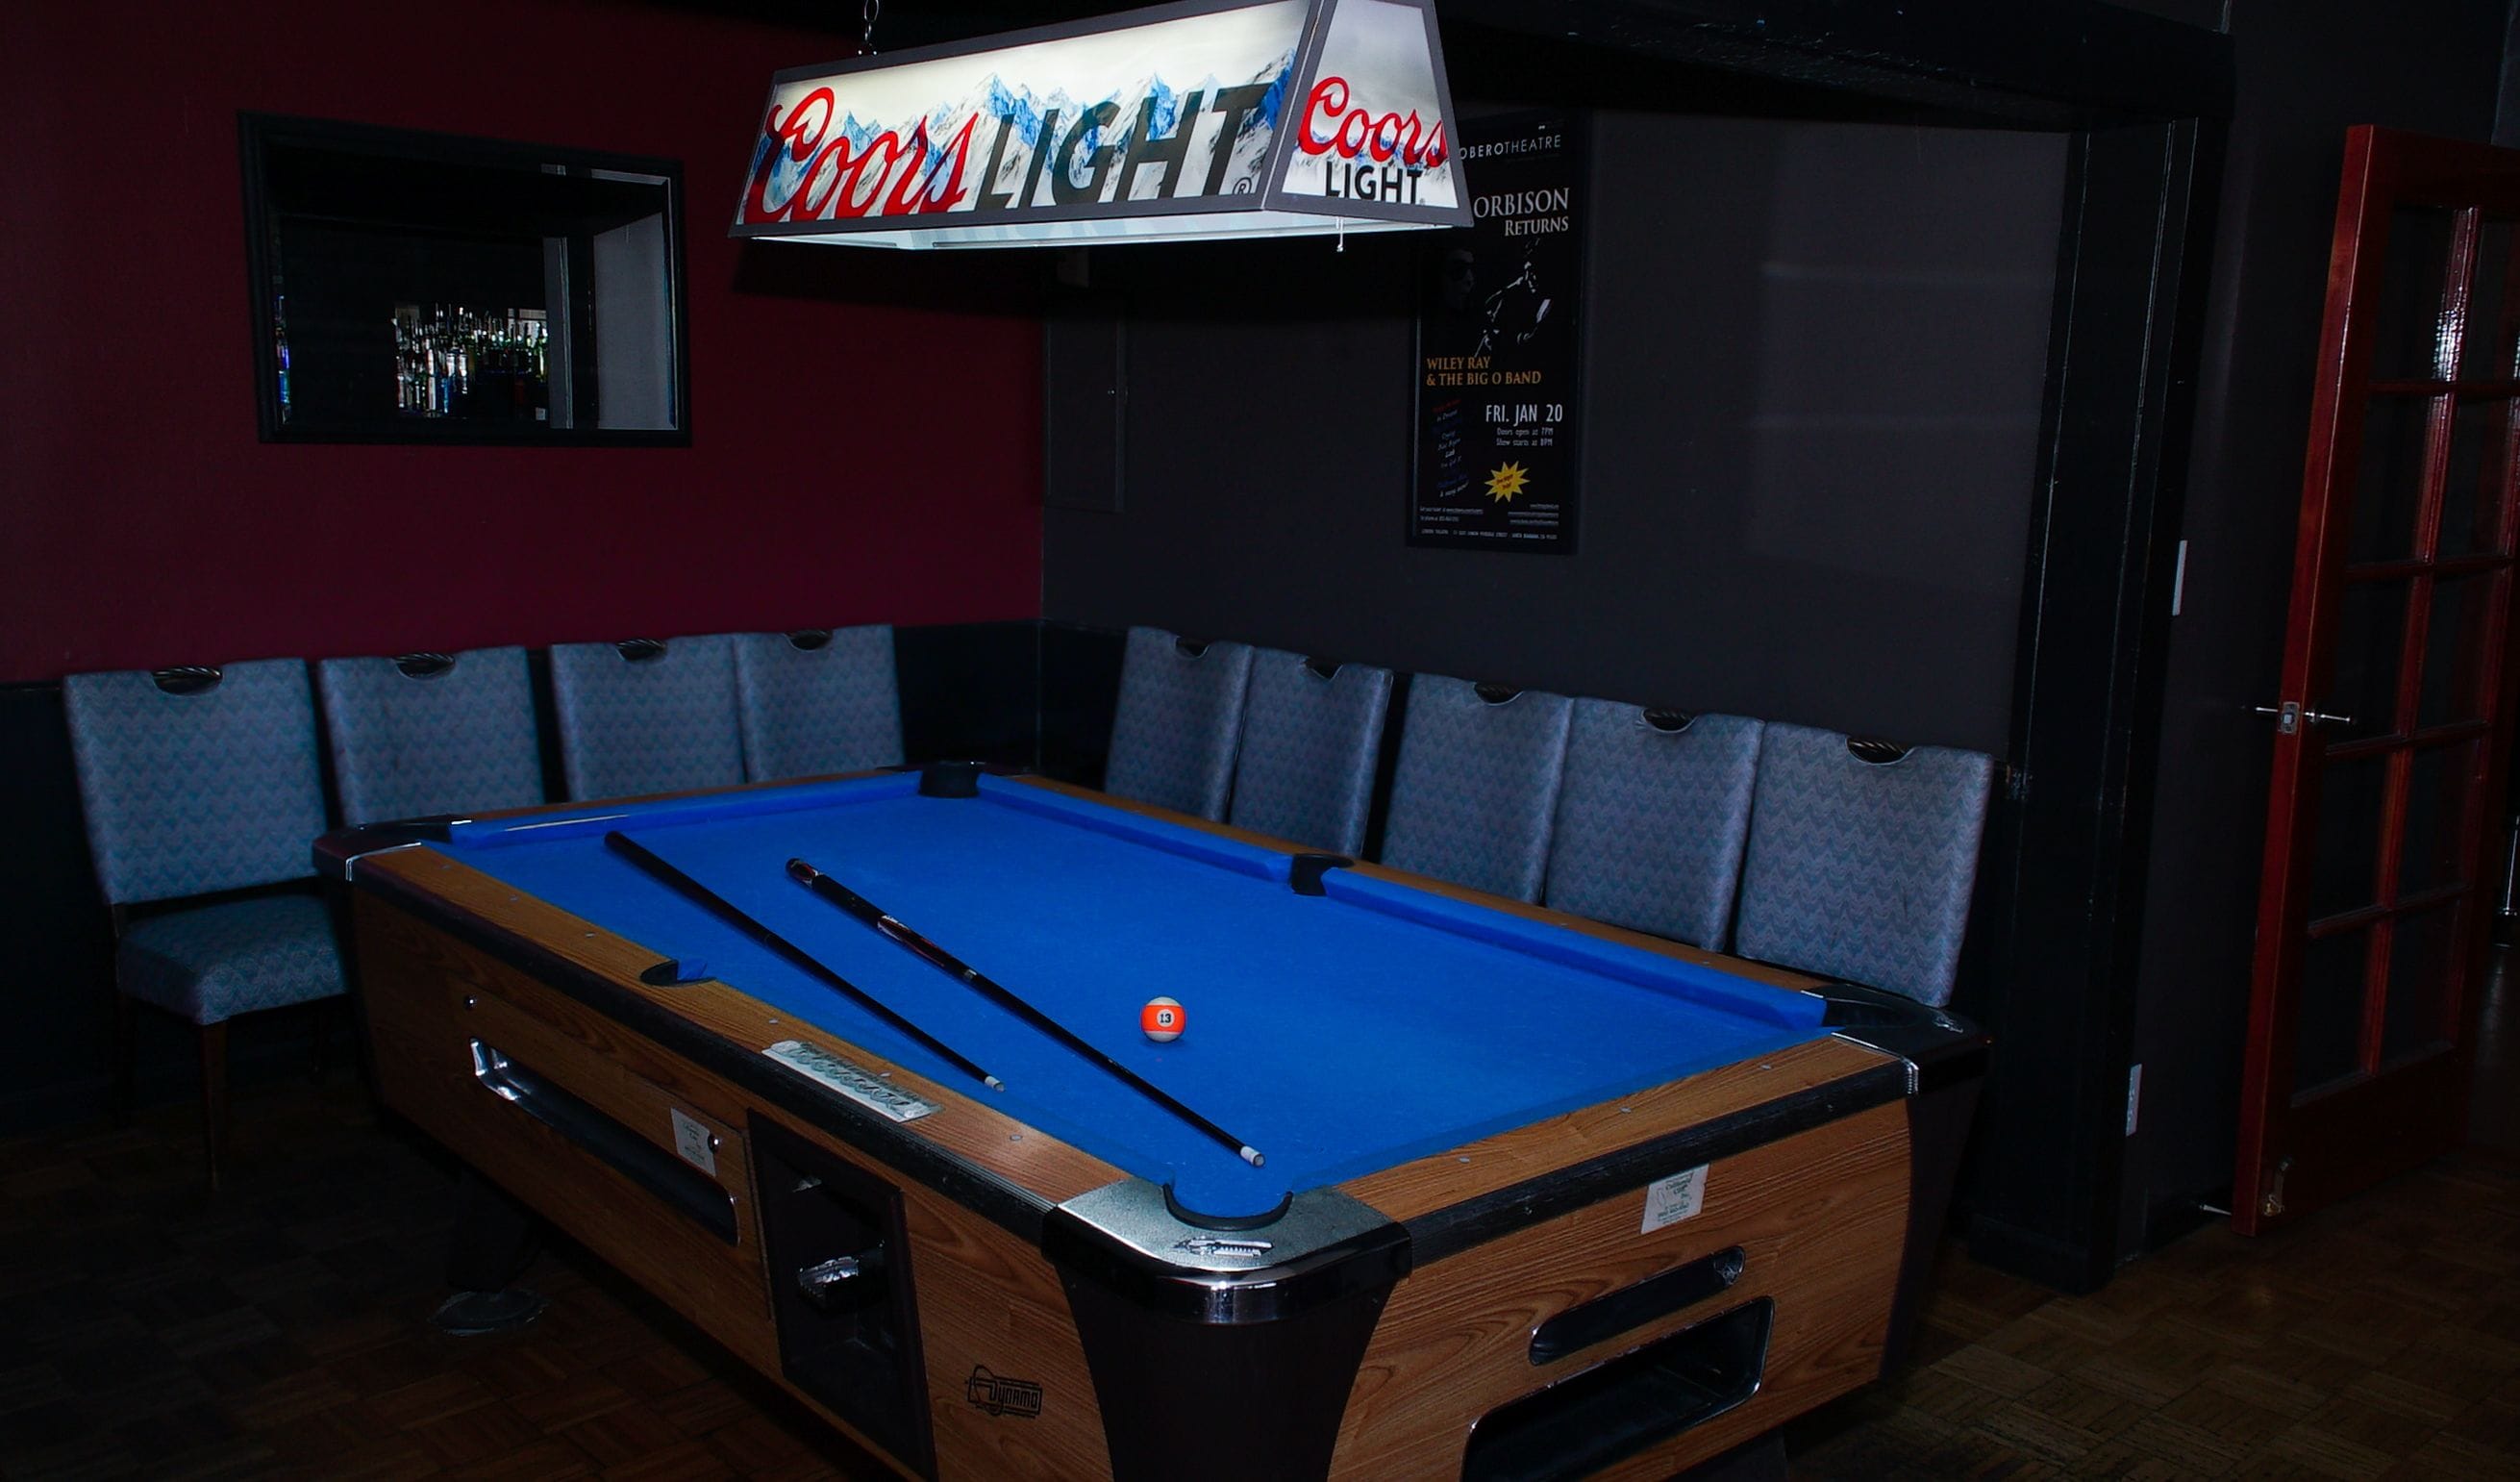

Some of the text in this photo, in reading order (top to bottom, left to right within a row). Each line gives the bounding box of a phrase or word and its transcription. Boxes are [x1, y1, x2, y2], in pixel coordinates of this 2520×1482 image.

[1297, 76, 1448, 168] Coors
[744, 82, 1274, 224] Coors LIGHT
[1459, 134, 1561, 160] OBEROTHEATRE
[1325, 161, 1424, 204] LIGHT
[1473, 188, 1569, 218] ORBISON
[1426, 356, 1491, 370] WILEY RAY
[1426, 370, 1542, 387] & THE BIG O BAND
[1485, 404, 1563, 427] FRI. JAN 20
[1160, 1013, 1172, 1023] 13
